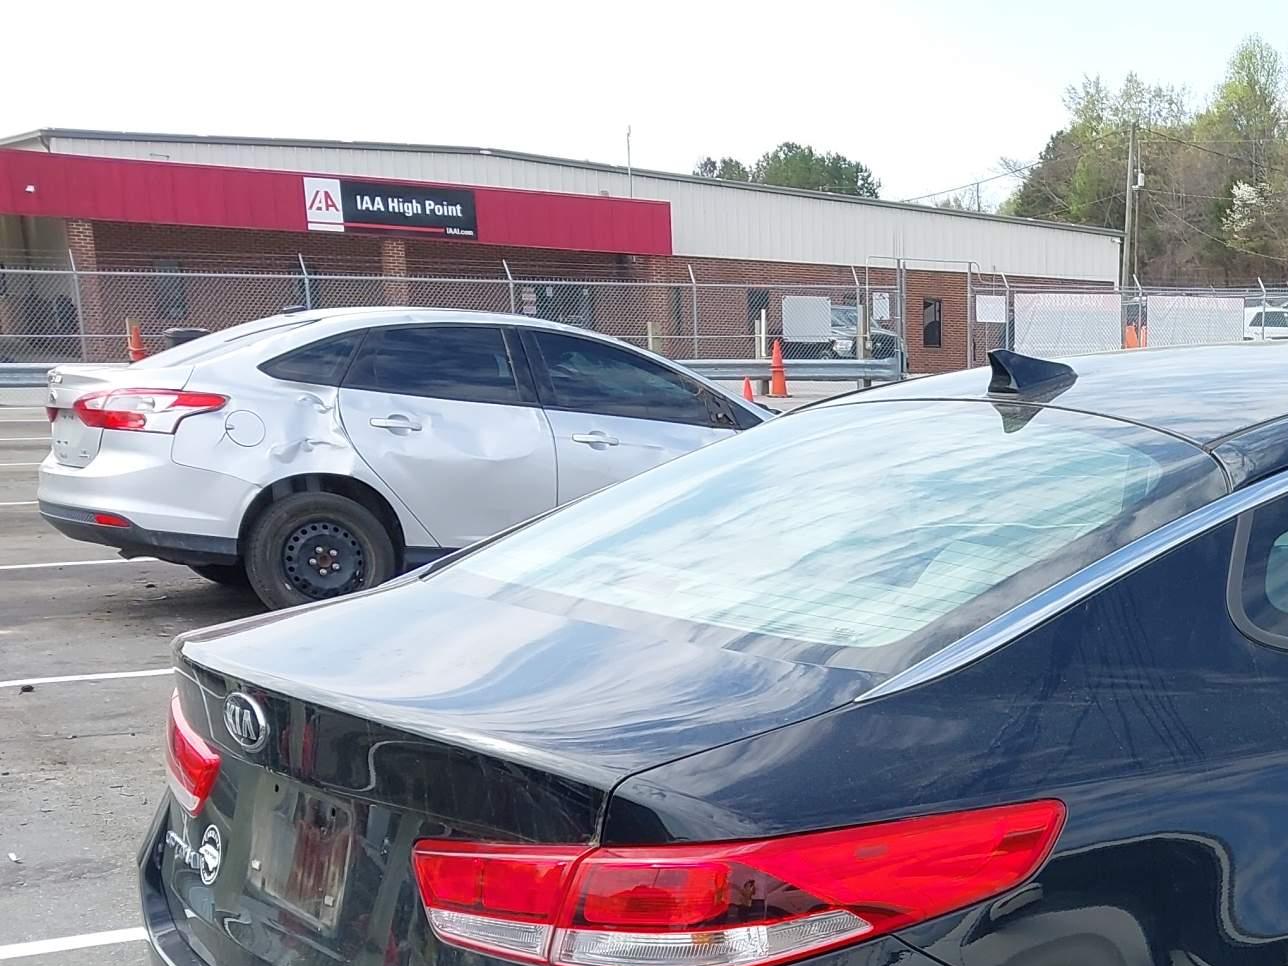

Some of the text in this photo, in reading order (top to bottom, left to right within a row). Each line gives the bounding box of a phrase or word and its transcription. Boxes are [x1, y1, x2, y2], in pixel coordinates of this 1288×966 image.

[356, 195, 463, 217] IAA High Point
[225, 702, 257, 740] KIA
